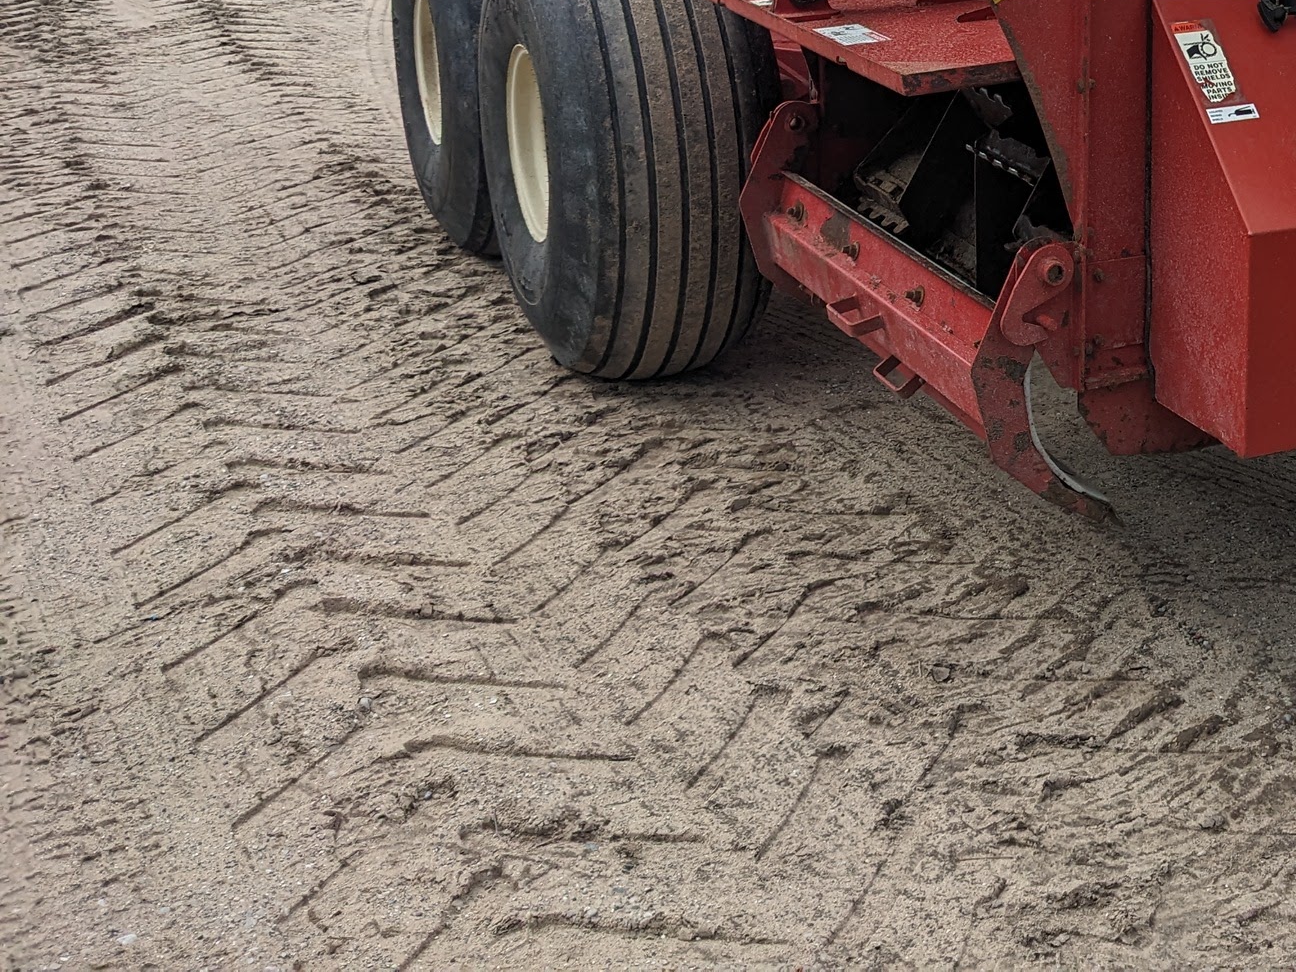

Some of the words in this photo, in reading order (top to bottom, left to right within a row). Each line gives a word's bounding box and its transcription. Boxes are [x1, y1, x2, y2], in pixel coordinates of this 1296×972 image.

[1194, 68, 1228, 76] REMOVE
[1196, 74, 1230, 82] SHIELDS
[1202, 80, 1233, 89] MOVING
[1207, 87, 1232, 95] PARTS
